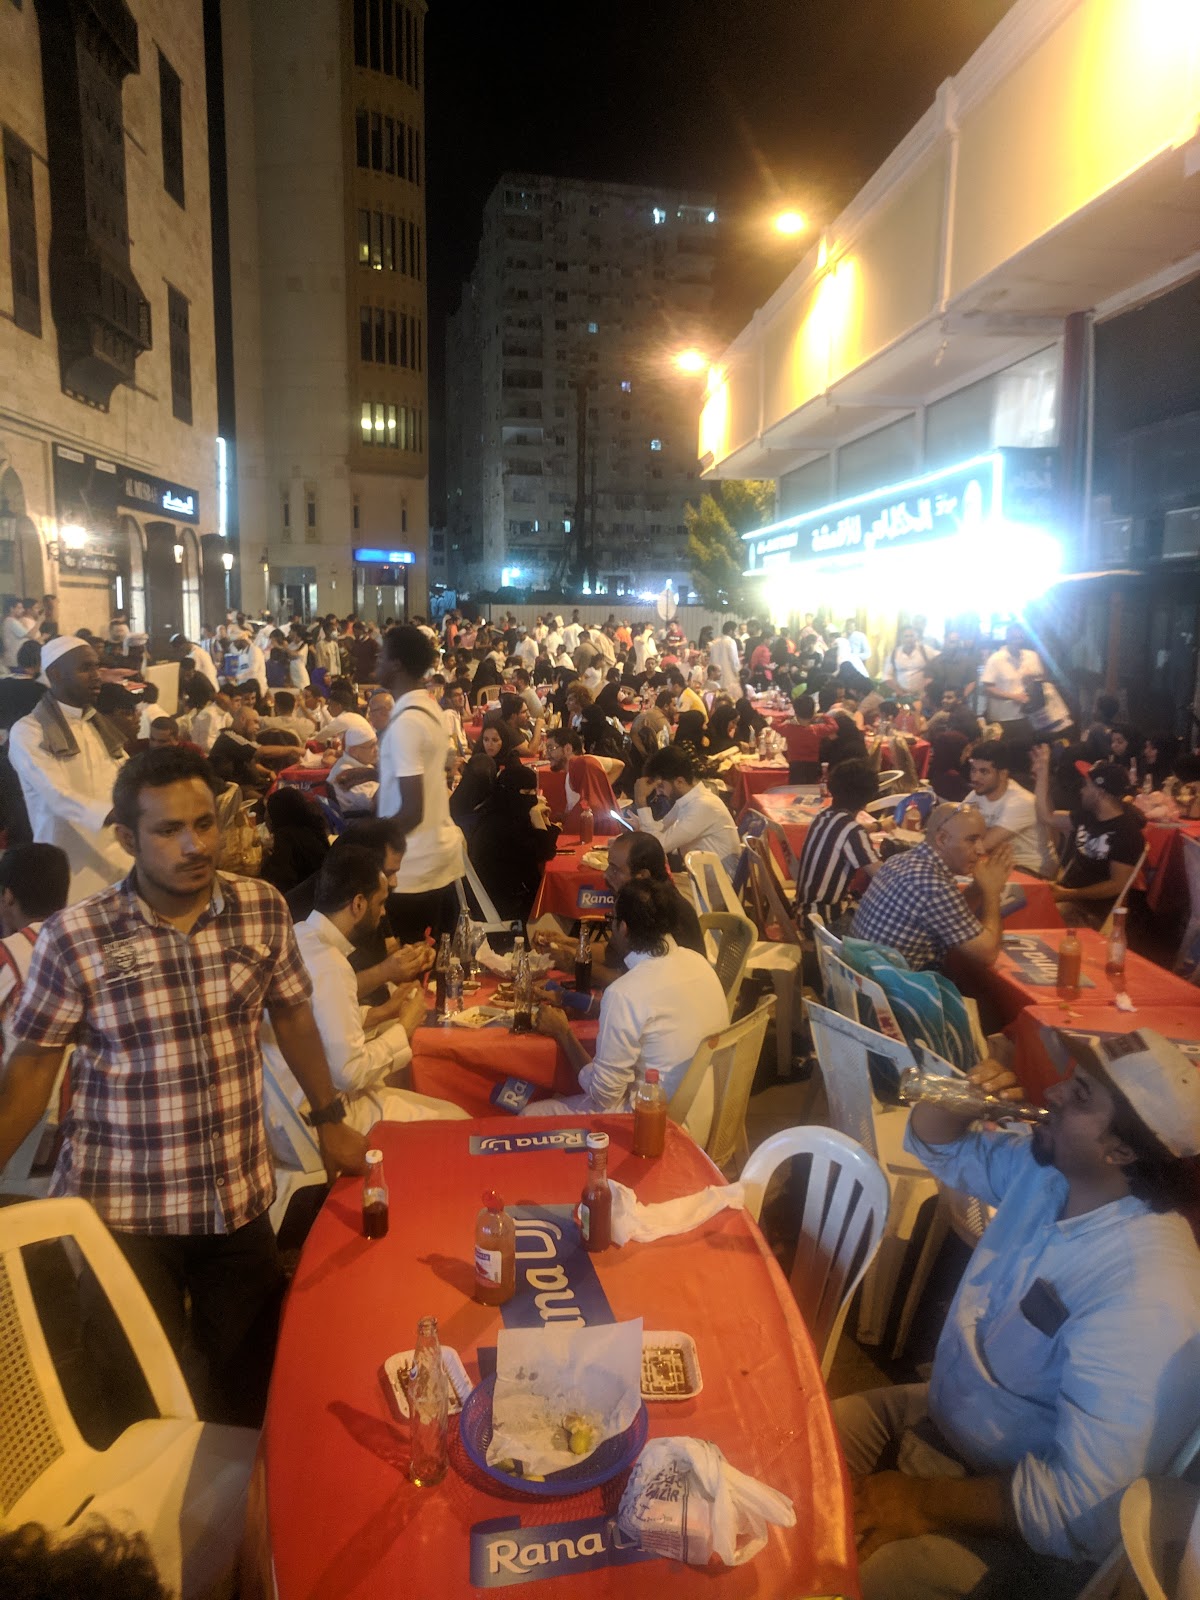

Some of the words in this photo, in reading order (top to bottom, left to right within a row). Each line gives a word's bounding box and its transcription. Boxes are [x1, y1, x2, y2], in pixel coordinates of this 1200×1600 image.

[581, 892, 615, 906] Rana
[503, 1078, 529, 1109] Ra
[516, 1131, 584, 1147] Rana
[485, 1531, 607, 1575] Rana
